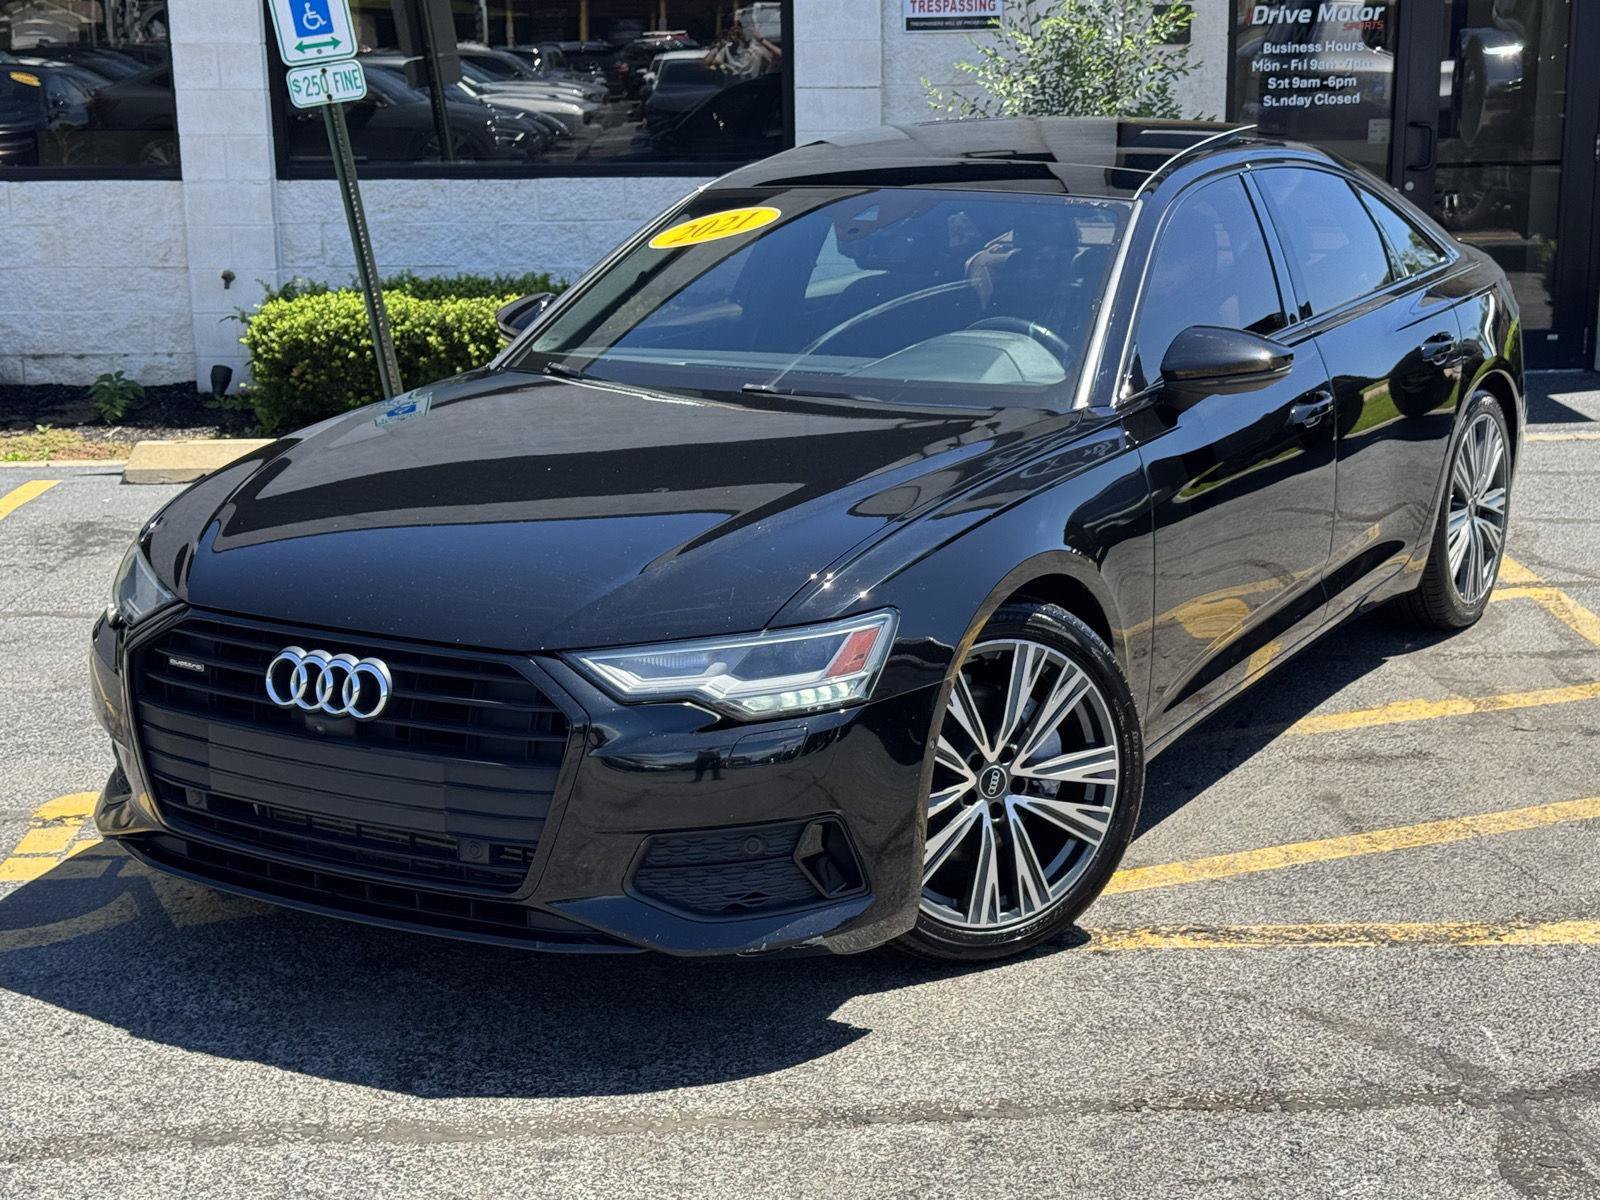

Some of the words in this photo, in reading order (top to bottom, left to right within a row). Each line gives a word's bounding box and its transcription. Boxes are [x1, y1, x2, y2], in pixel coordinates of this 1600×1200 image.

[910, 0, 997, 13] TRESPASSING
[1317, 3, 1386, 22] Motor
[1263, 42, 1322, 54] Business
[1325, 40, 1365, 52] Hours
[332, 69, 362, 93] FINE
[1291, 77, 1321, 88] 9am
[1314, 92, 1360, 105] Closed
[667, 211, 760, 245] 2021
